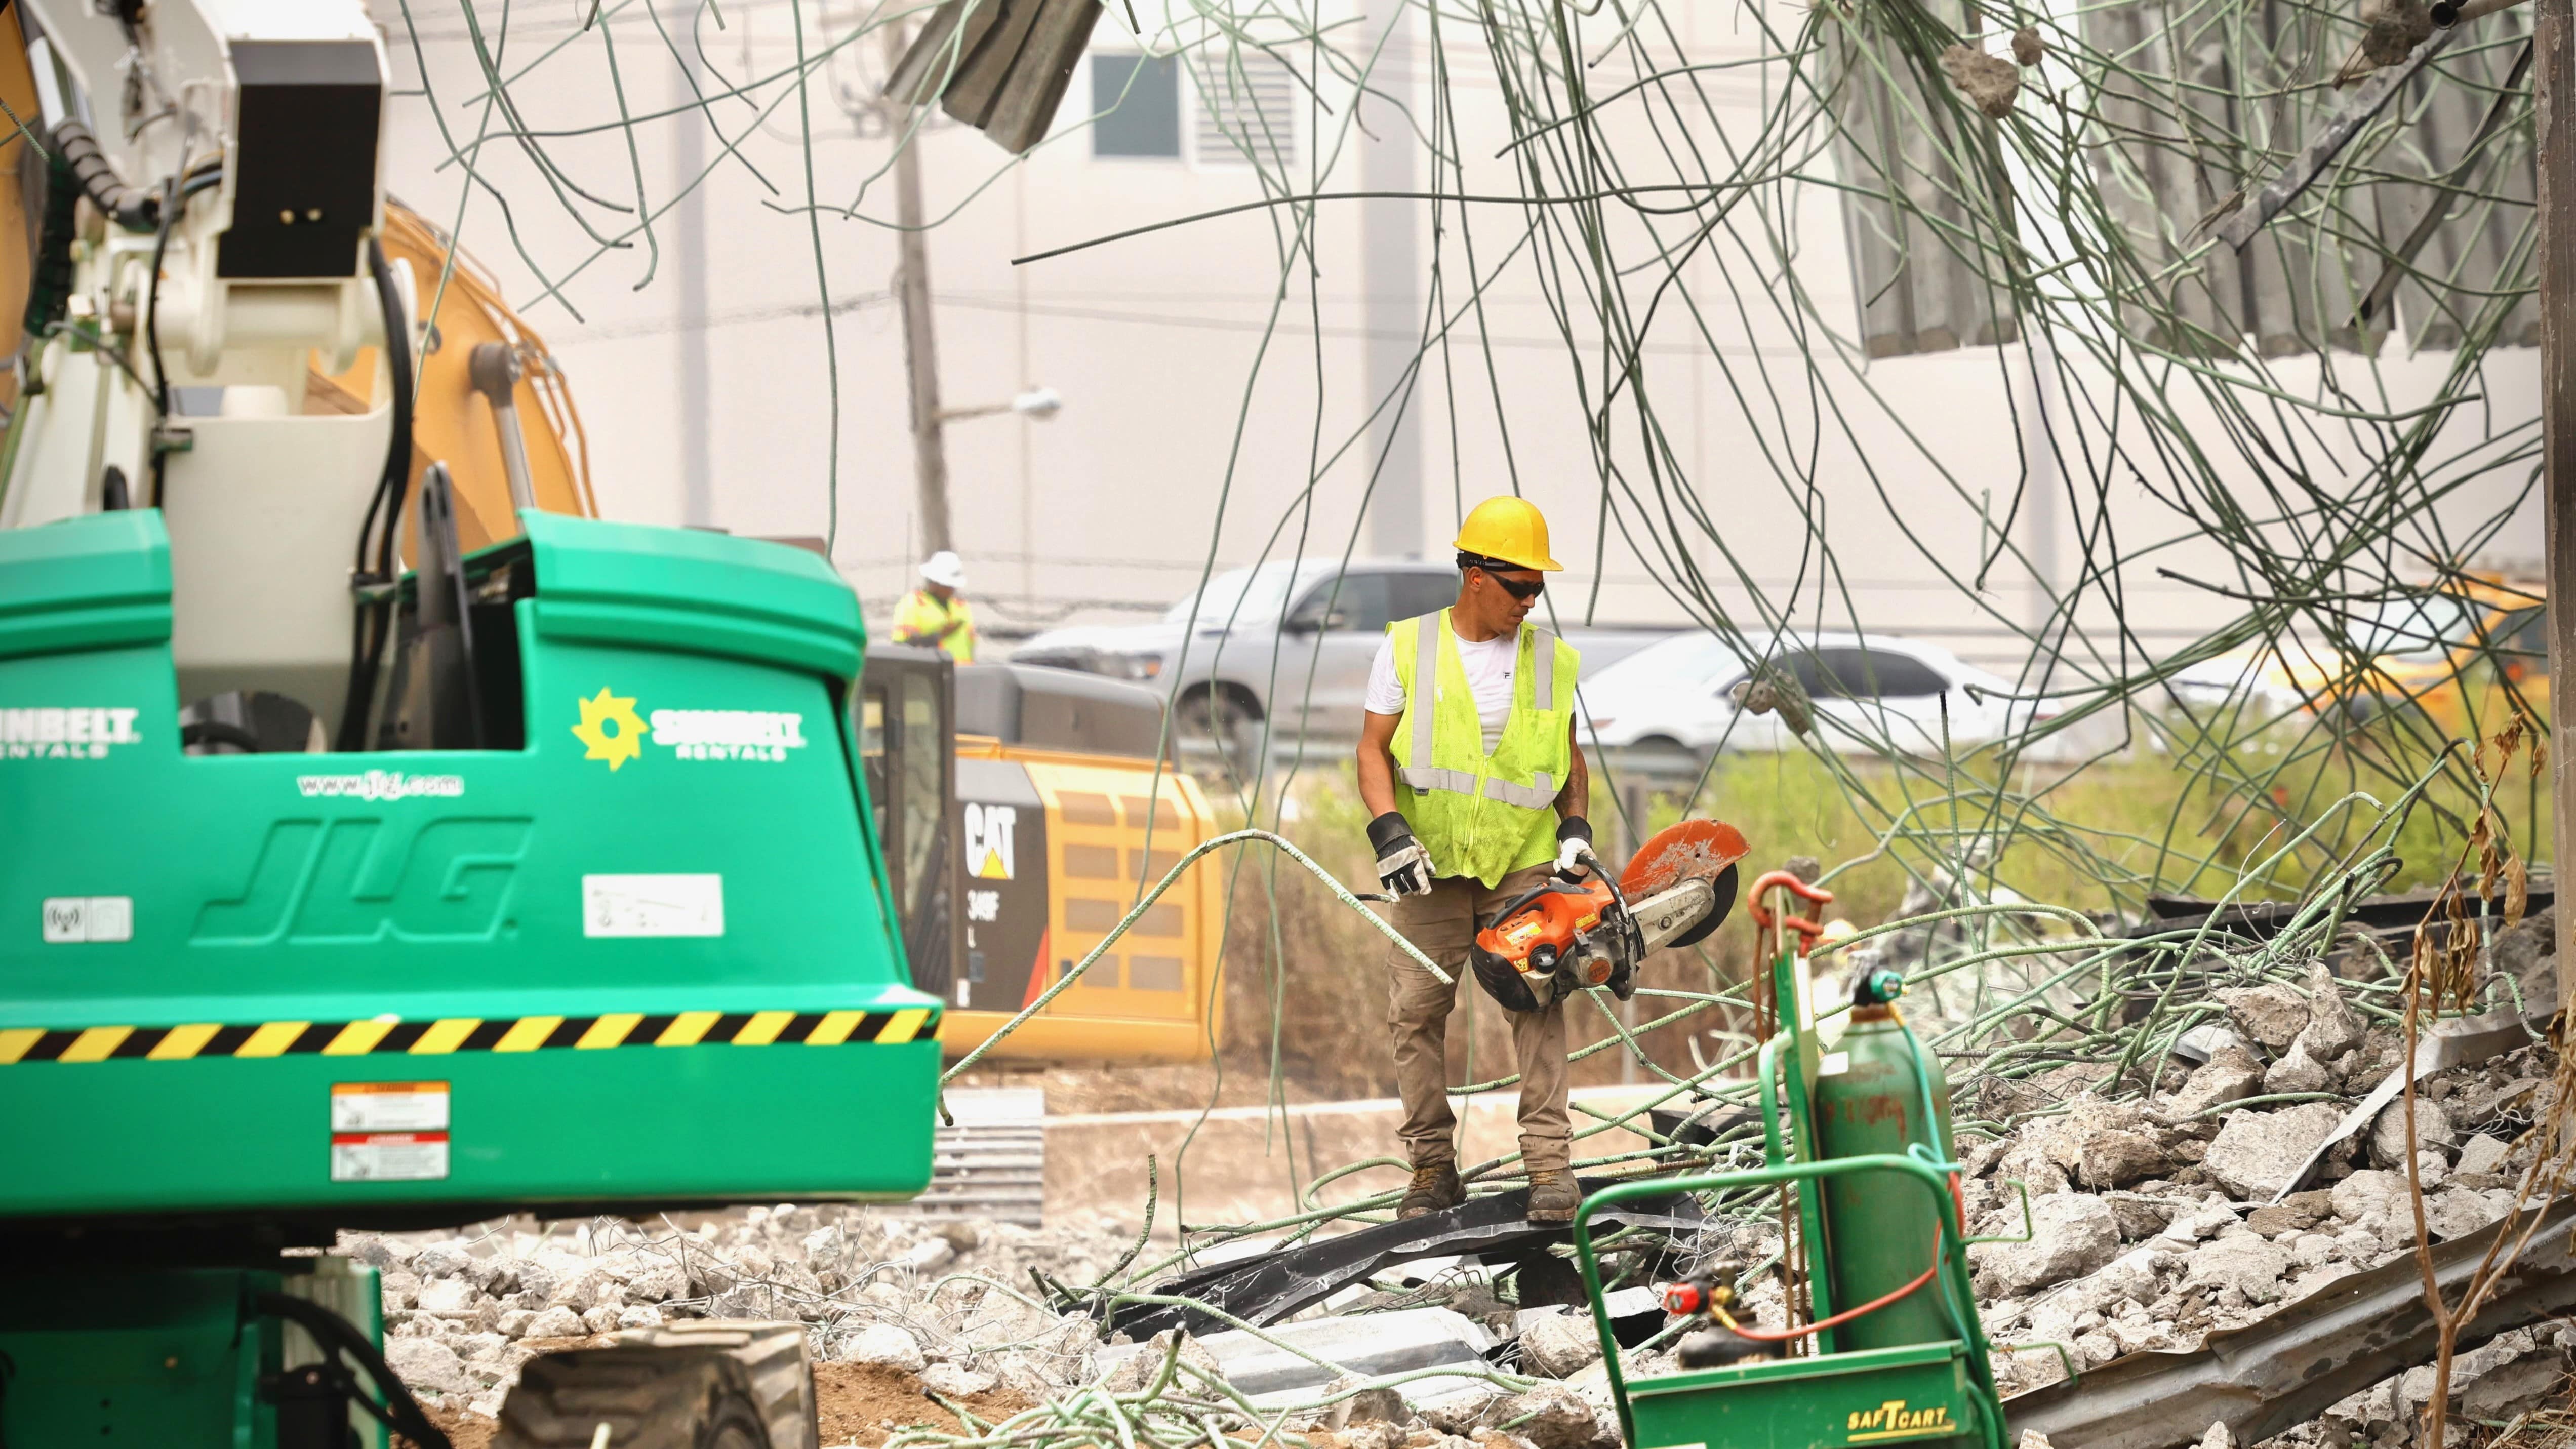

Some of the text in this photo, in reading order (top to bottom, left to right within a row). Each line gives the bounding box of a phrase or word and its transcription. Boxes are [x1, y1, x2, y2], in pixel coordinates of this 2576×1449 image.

[0, 708, 139, 743] NBELT
[676, 744, 787, 762] RENTALS
[964, 802, 1016, 880] CAT
[188, 816, 534, 946] JLG
